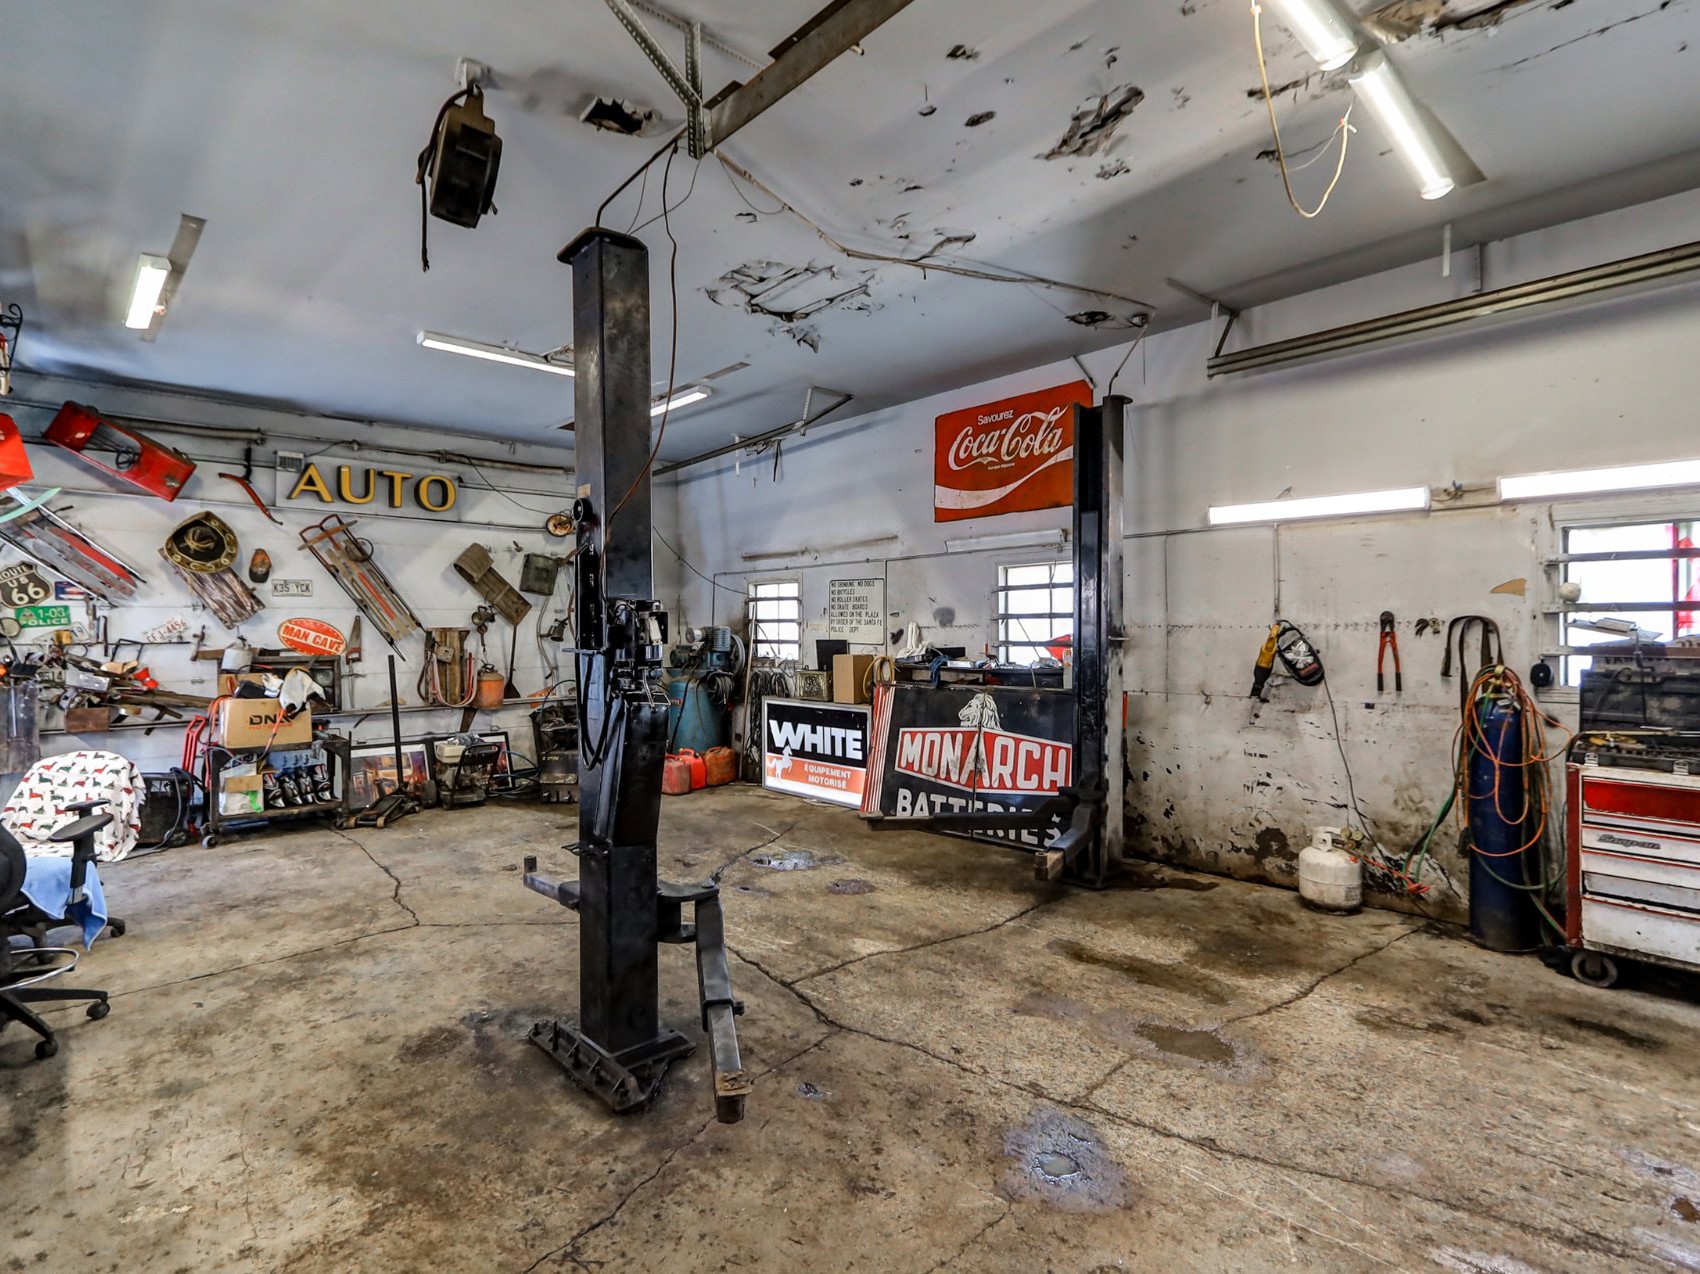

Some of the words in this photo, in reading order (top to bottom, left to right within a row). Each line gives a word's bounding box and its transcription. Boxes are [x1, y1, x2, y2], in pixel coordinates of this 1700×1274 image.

[978, 409, 1014, 426] Savourez
[948, 404, 1069, 471] Coca-Cola
[287, 463, 457, 512] AUTO
[11, 582, 46, 605] 66
[865, 611, 879, 619] PLAZA
[282, 625, 311, 642] MAN
[312, 634, 343, 653] CAVE
[768, 719, 863, 761] WHITE
[804, 763, 852, 779] ÉQUIPEMENT
[900, 732, 1067, 790] MONARCH
[808, 775, 847, 789] MOTORISÉ
